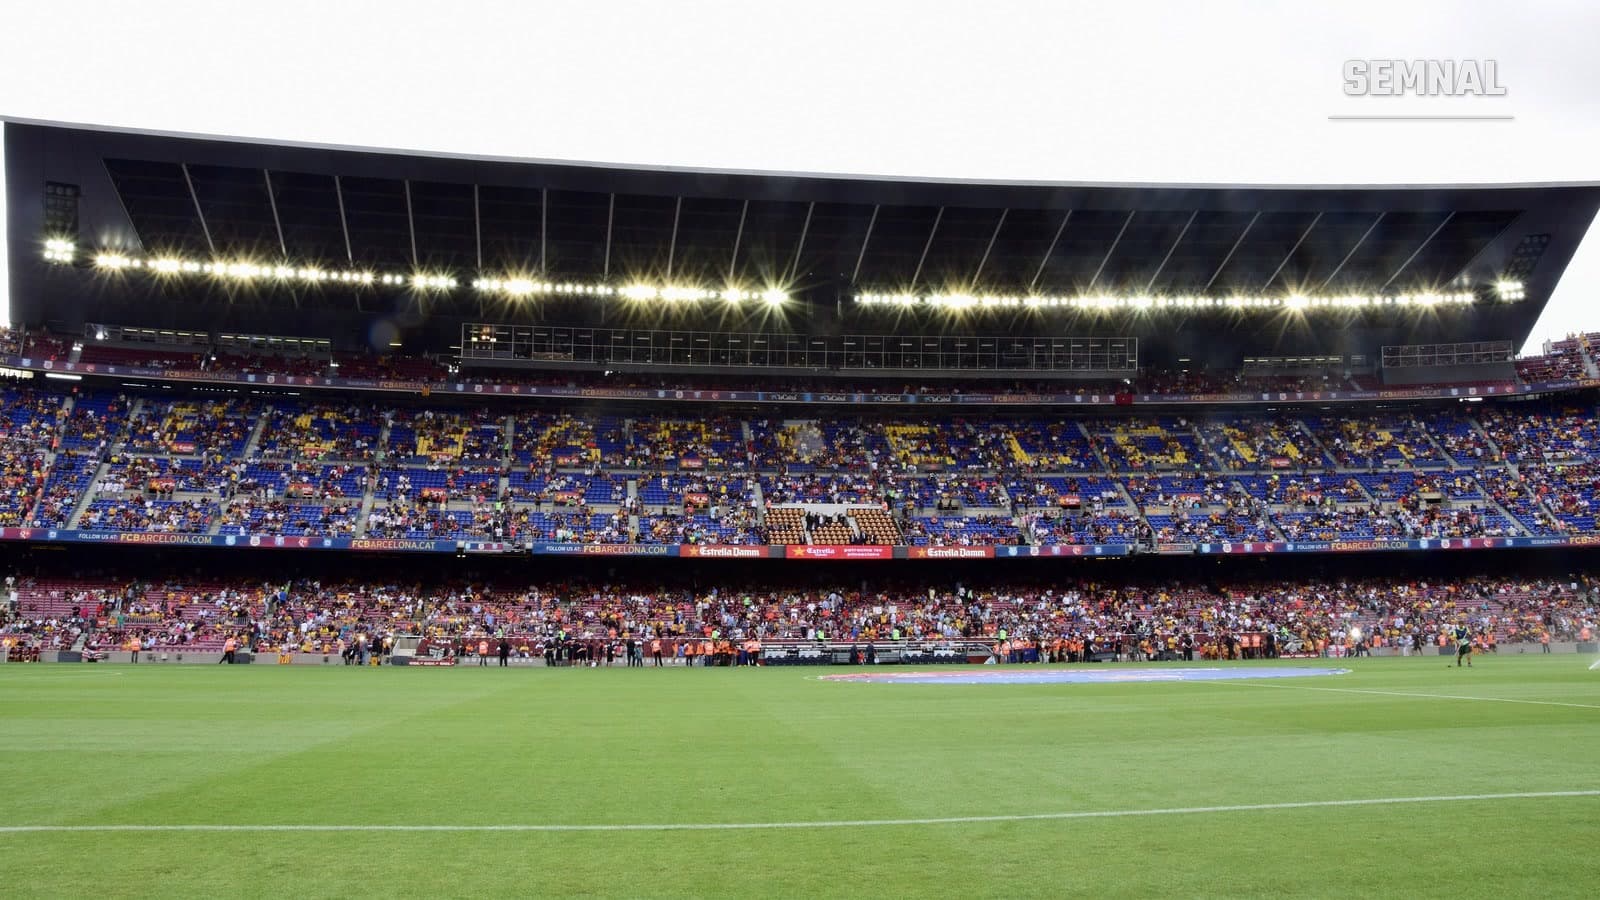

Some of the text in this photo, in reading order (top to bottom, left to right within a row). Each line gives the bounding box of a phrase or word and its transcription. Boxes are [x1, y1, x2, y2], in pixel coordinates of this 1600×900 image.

[120, 533, 212, 544] FCBARCELONA.COM
[351, 540, 436, 550] FCBARCELONA.CAT
[583, 545, 667, 554] FCBARCELONA.COM
[1331, 541, 1409, 551] FCBARCELONA.COM
[700, 547, 760, 556] Estrella Damm
[927, 548, 986, 557] Estrella Damm
